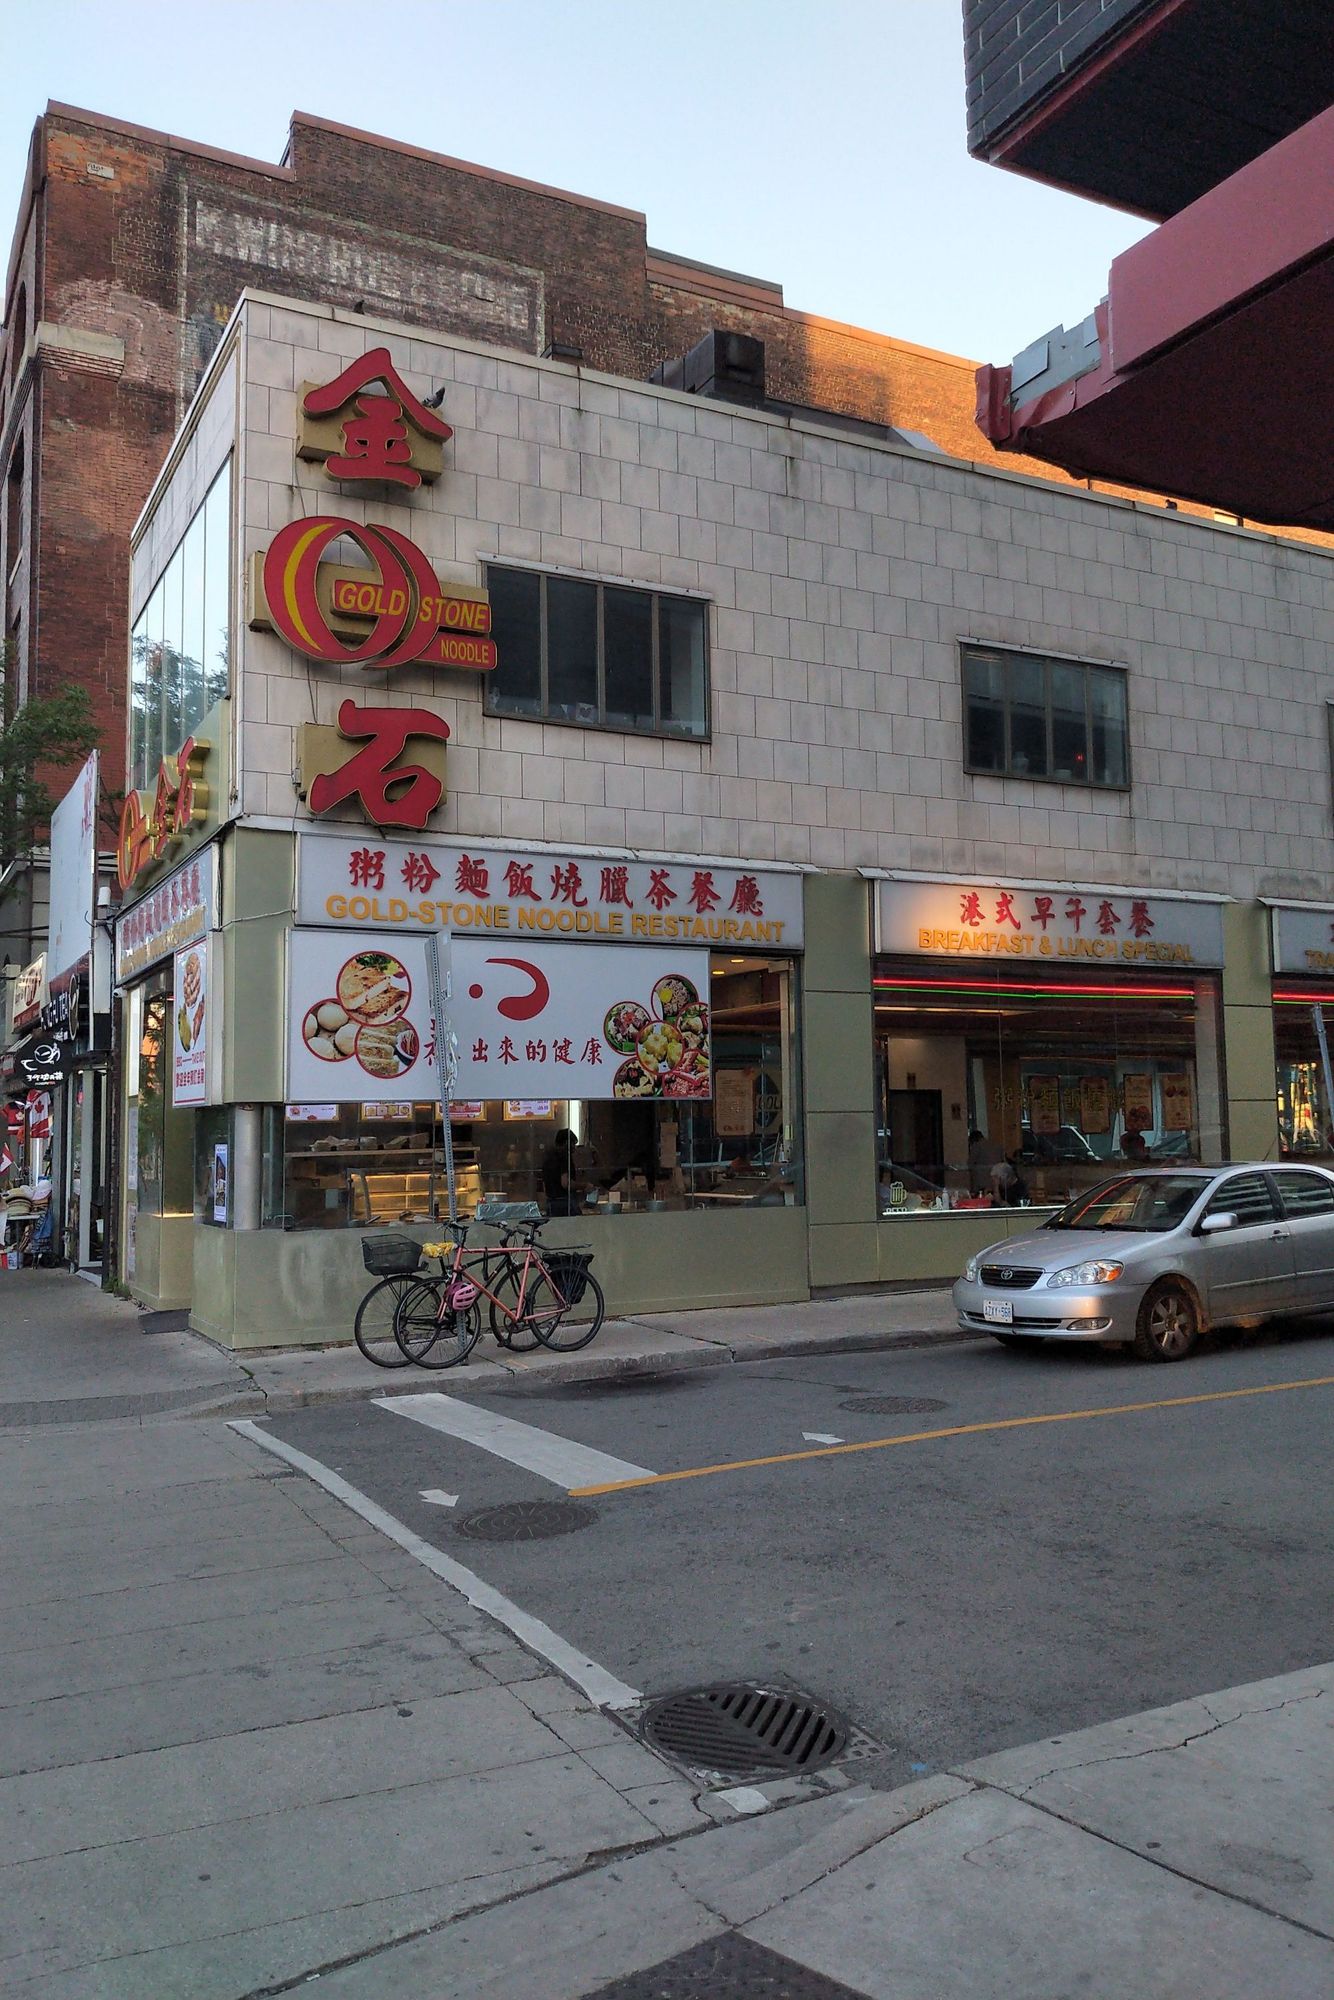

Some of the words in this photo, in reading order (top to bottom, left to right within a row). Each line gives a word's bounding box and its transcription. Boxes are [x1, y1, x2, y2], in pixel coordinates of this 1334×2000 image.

[303, 347, 454, 490] 金
[338, 581, 406, 617] GOLD
[418, 594, 490, 632] STONE
[440, 639, 490, 665] NOODLE
[305, 698, 451, 829] 石
[325, 894, 511, 929] GOLD-STONE
[518, 905, 624, 934] NOODLE
[631, 913, 786, 943] RESTAURANT
[959, 891, 1156, 938] 港式早午套餐
[918, 928, 1034, 954] BREAKFAST
[1039, 935, 1051, 955] &
[1057, 936, 1117, 959] LUNCH
[1122, 939, 1194, 963] SPECIAL
